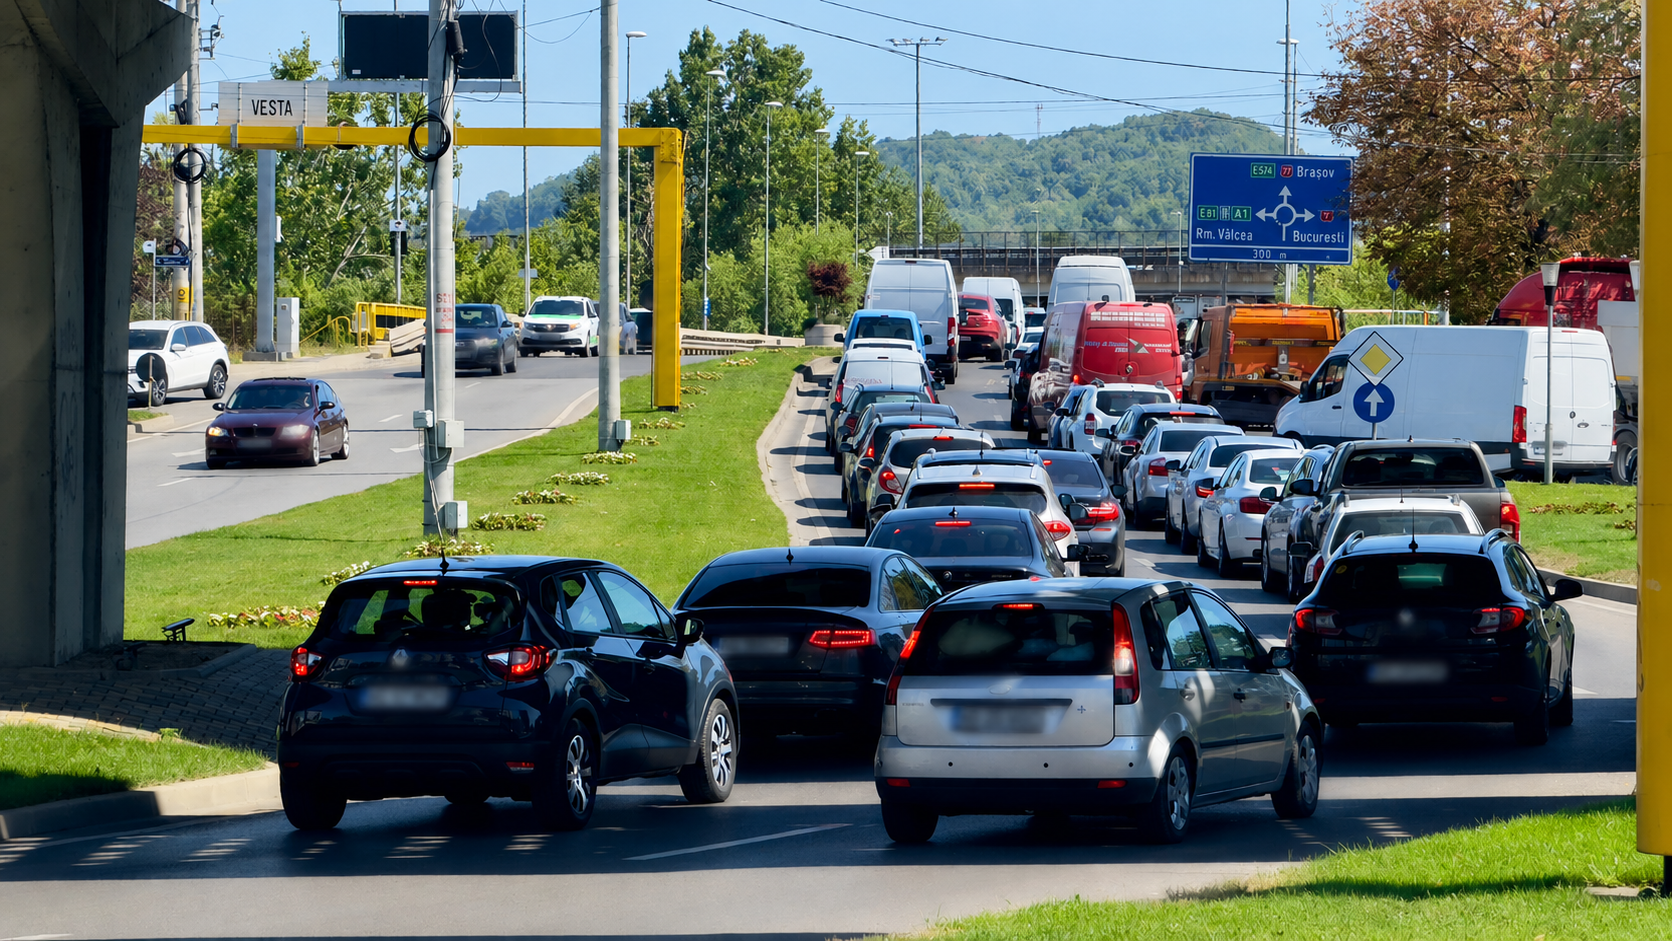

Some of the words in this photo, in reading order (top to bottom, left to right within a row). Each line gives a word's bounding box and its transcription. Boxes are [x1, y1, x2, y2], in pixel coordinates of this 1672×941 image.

[251, 99, 293, 116] VESTA
[1252, 165, 1273, 176] E574
[1297, 165, 1335, 181] Brașov
[1234, 208, 1248, 219] A1
[1196, 227, 1216, 240] Rm.
[1218, 228, 1253, 241] Vâlcea
[1252, 249, 1271, 259] 300
[1279, 252, 1287, 260] m
